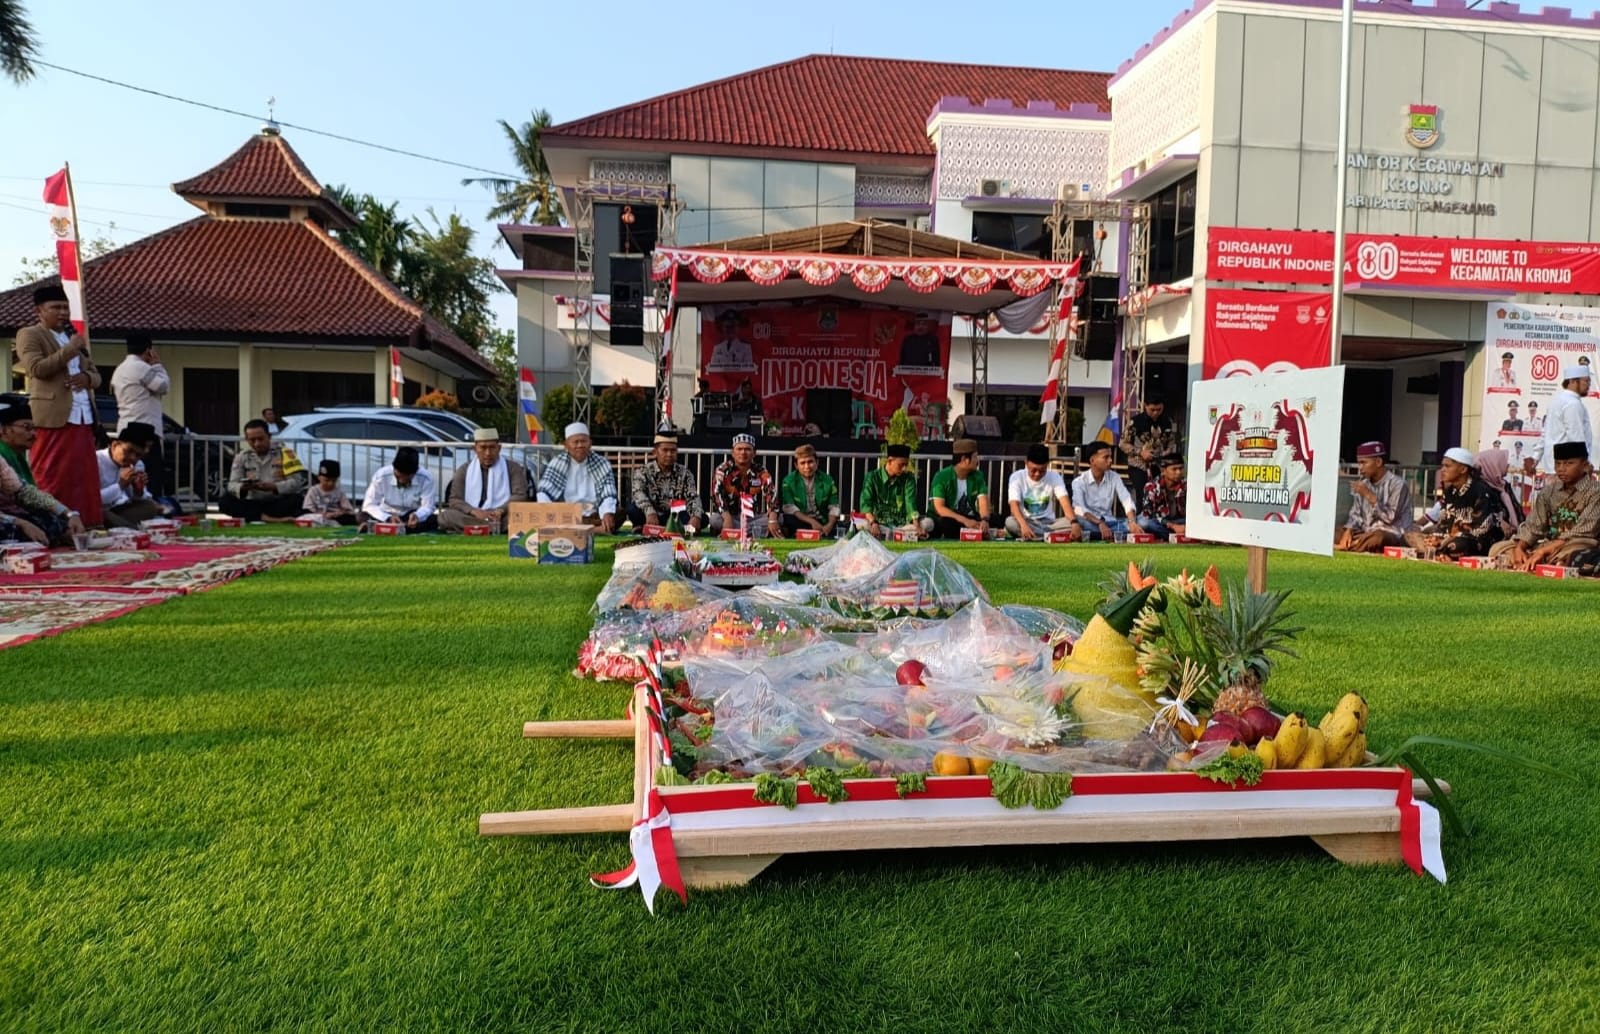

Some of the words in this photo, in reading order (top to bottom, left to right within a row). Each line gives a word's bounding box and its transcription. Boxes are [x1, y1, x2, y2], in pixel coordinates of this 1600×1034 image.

[1385, 176, 1452, 195] KRONJO
[1418, 199, 1497, 216] TANGERANG
[1218, 241, 1292, 255] DIRGAHAYU
[1450, 248, 1510, 265] WELCOME
[1512, 251, 1527, 265] TO
[1217, 256, 1281, 269] REPUBLIK
[1357, 241, 1398, 280] 80
[1450, 266, 1522, 282] KECAMATAN
[1525, 268, 1571, 284] KRONJO
[1216, 302, 1244, 311] Bersatu
[1245, 303, 1279, 312] Berdaulat
[1216, 311, 1241, 321] Rakyat
[1242, 312, 1276, 322] Sejahtera
[1504, 322, 1534, 331] PEMERINTAH
[1535, 324, 1562, 333] KABUPATEN
[772, 346, 830, 357] DIRGAHAYU
[833, 347, 880, 357] REPUBLIK
[1496, 338, 1532, 349] DIRGAHAYU
[1532, 340, 1562, 351] REPUBLIK
[1563, 341, 1597, 353] INDONESIA
[1531, 354, 1559, 381] 80
[761, 358, 887, 401] INDONESIA
[1231, 464, 1281, 483] TUMPENG
[1221, 487, 1242, 502] DESA
[1243, 487, 1290, 506] MUNCUNG
